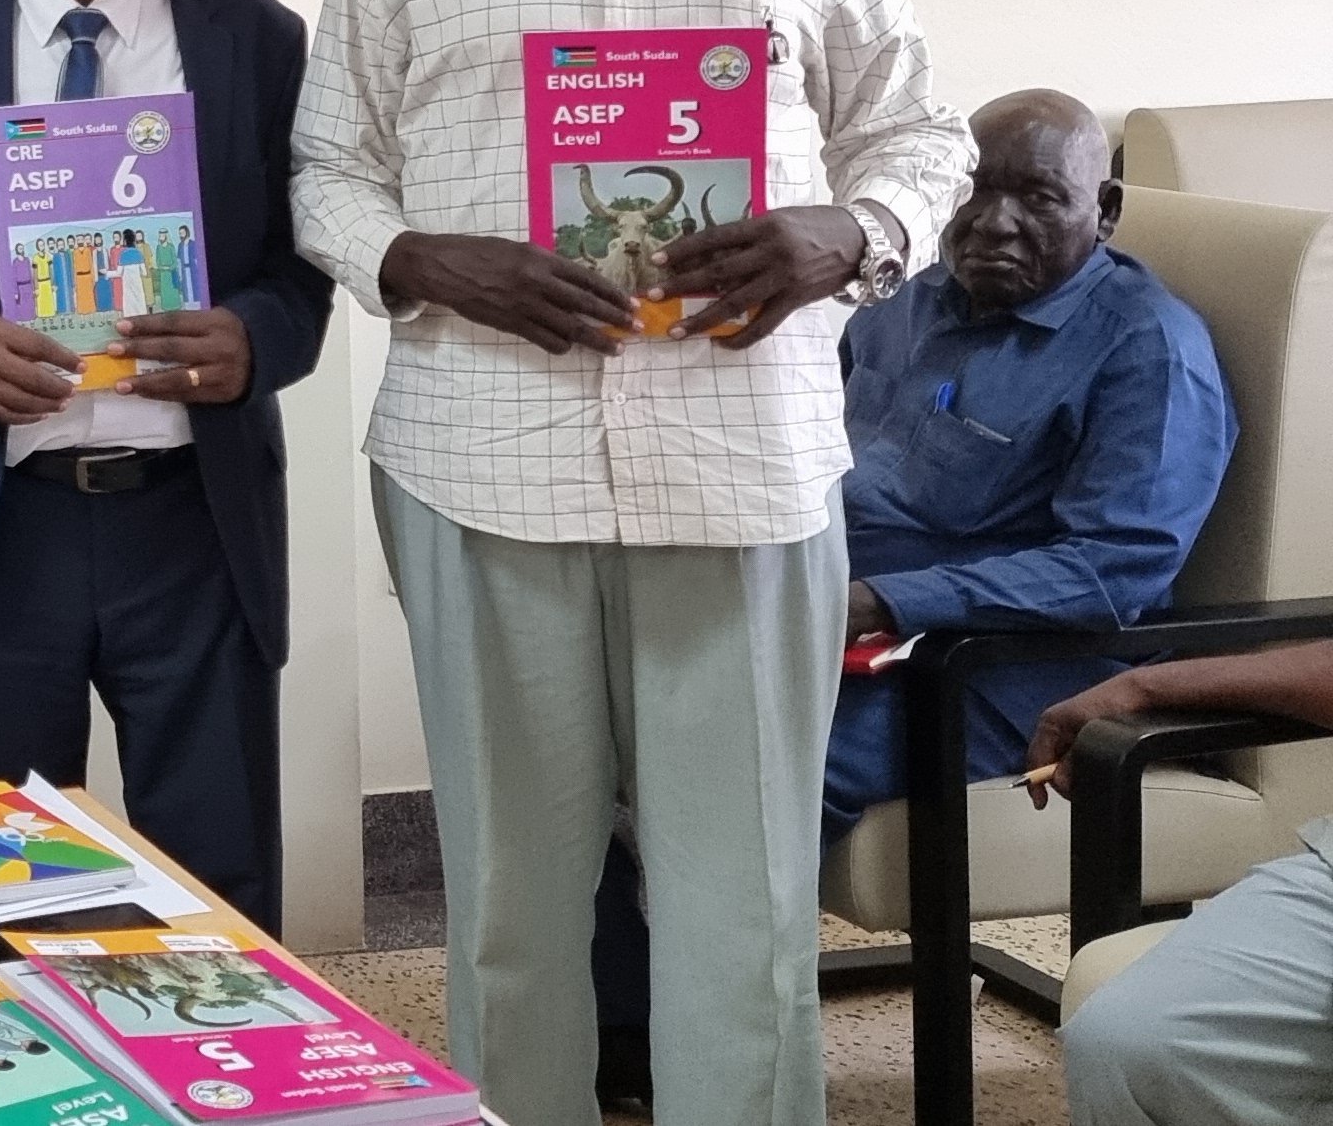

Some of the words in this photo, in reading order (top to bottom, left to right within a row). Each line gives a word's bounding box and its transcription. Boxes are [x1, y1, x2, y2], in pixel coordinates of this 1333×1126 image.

[605, 51, 640, 62] South
[643, 50, 679, 61] Sudan
[546, 72, 645, 90] ENGLISH
[52, 126, 83, 137] South
[85, 123, 118, 134] Sudan
[552, 103, 625, 125] ASEP
[667, 100, 701, 146] 5
[553, 131, 601, 146] Level
[5, 144, 44, 162] CRE
[8, 169, 74, 192] ASEP
[111, 154, 148, 208] 6
[11, 196, 54, 213] Level
[304, 1031, 362, 1043] Level
[198, 1041, 255, 1073] 5
[300, 1042, 377, 1063] ASEP
[299, 1061, 416, 1082] ENGLISH
[51, 1091, 114, 1116] Level
[50, 1104, 129, 1126] ASE
